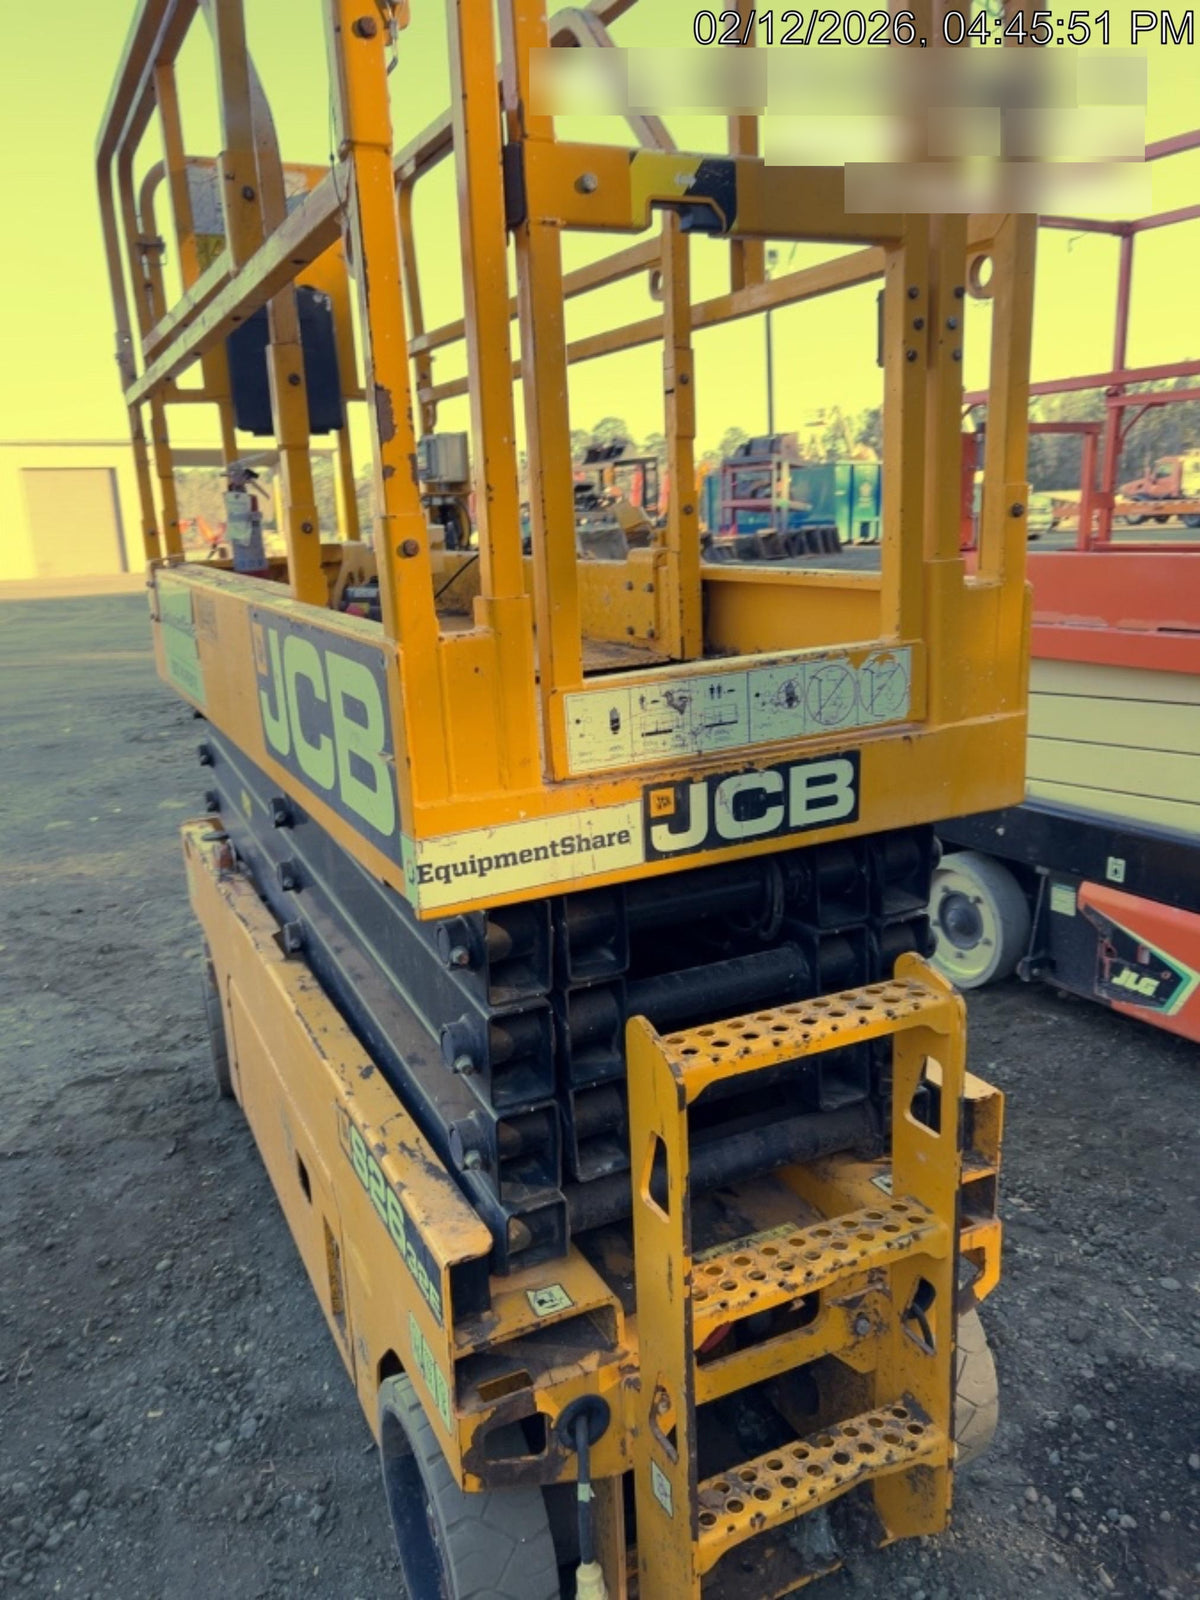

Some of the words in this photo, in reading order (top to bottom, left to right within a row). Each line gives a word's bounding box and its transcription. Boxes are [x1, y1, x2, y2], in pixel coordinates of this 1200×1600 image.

[260, 629, 395, 837] JCB
[650, 759, 856, 853] JCB
[417, 829, 631, 885] EquipmentShare
[1112, 967, 1160, 997] JLG
